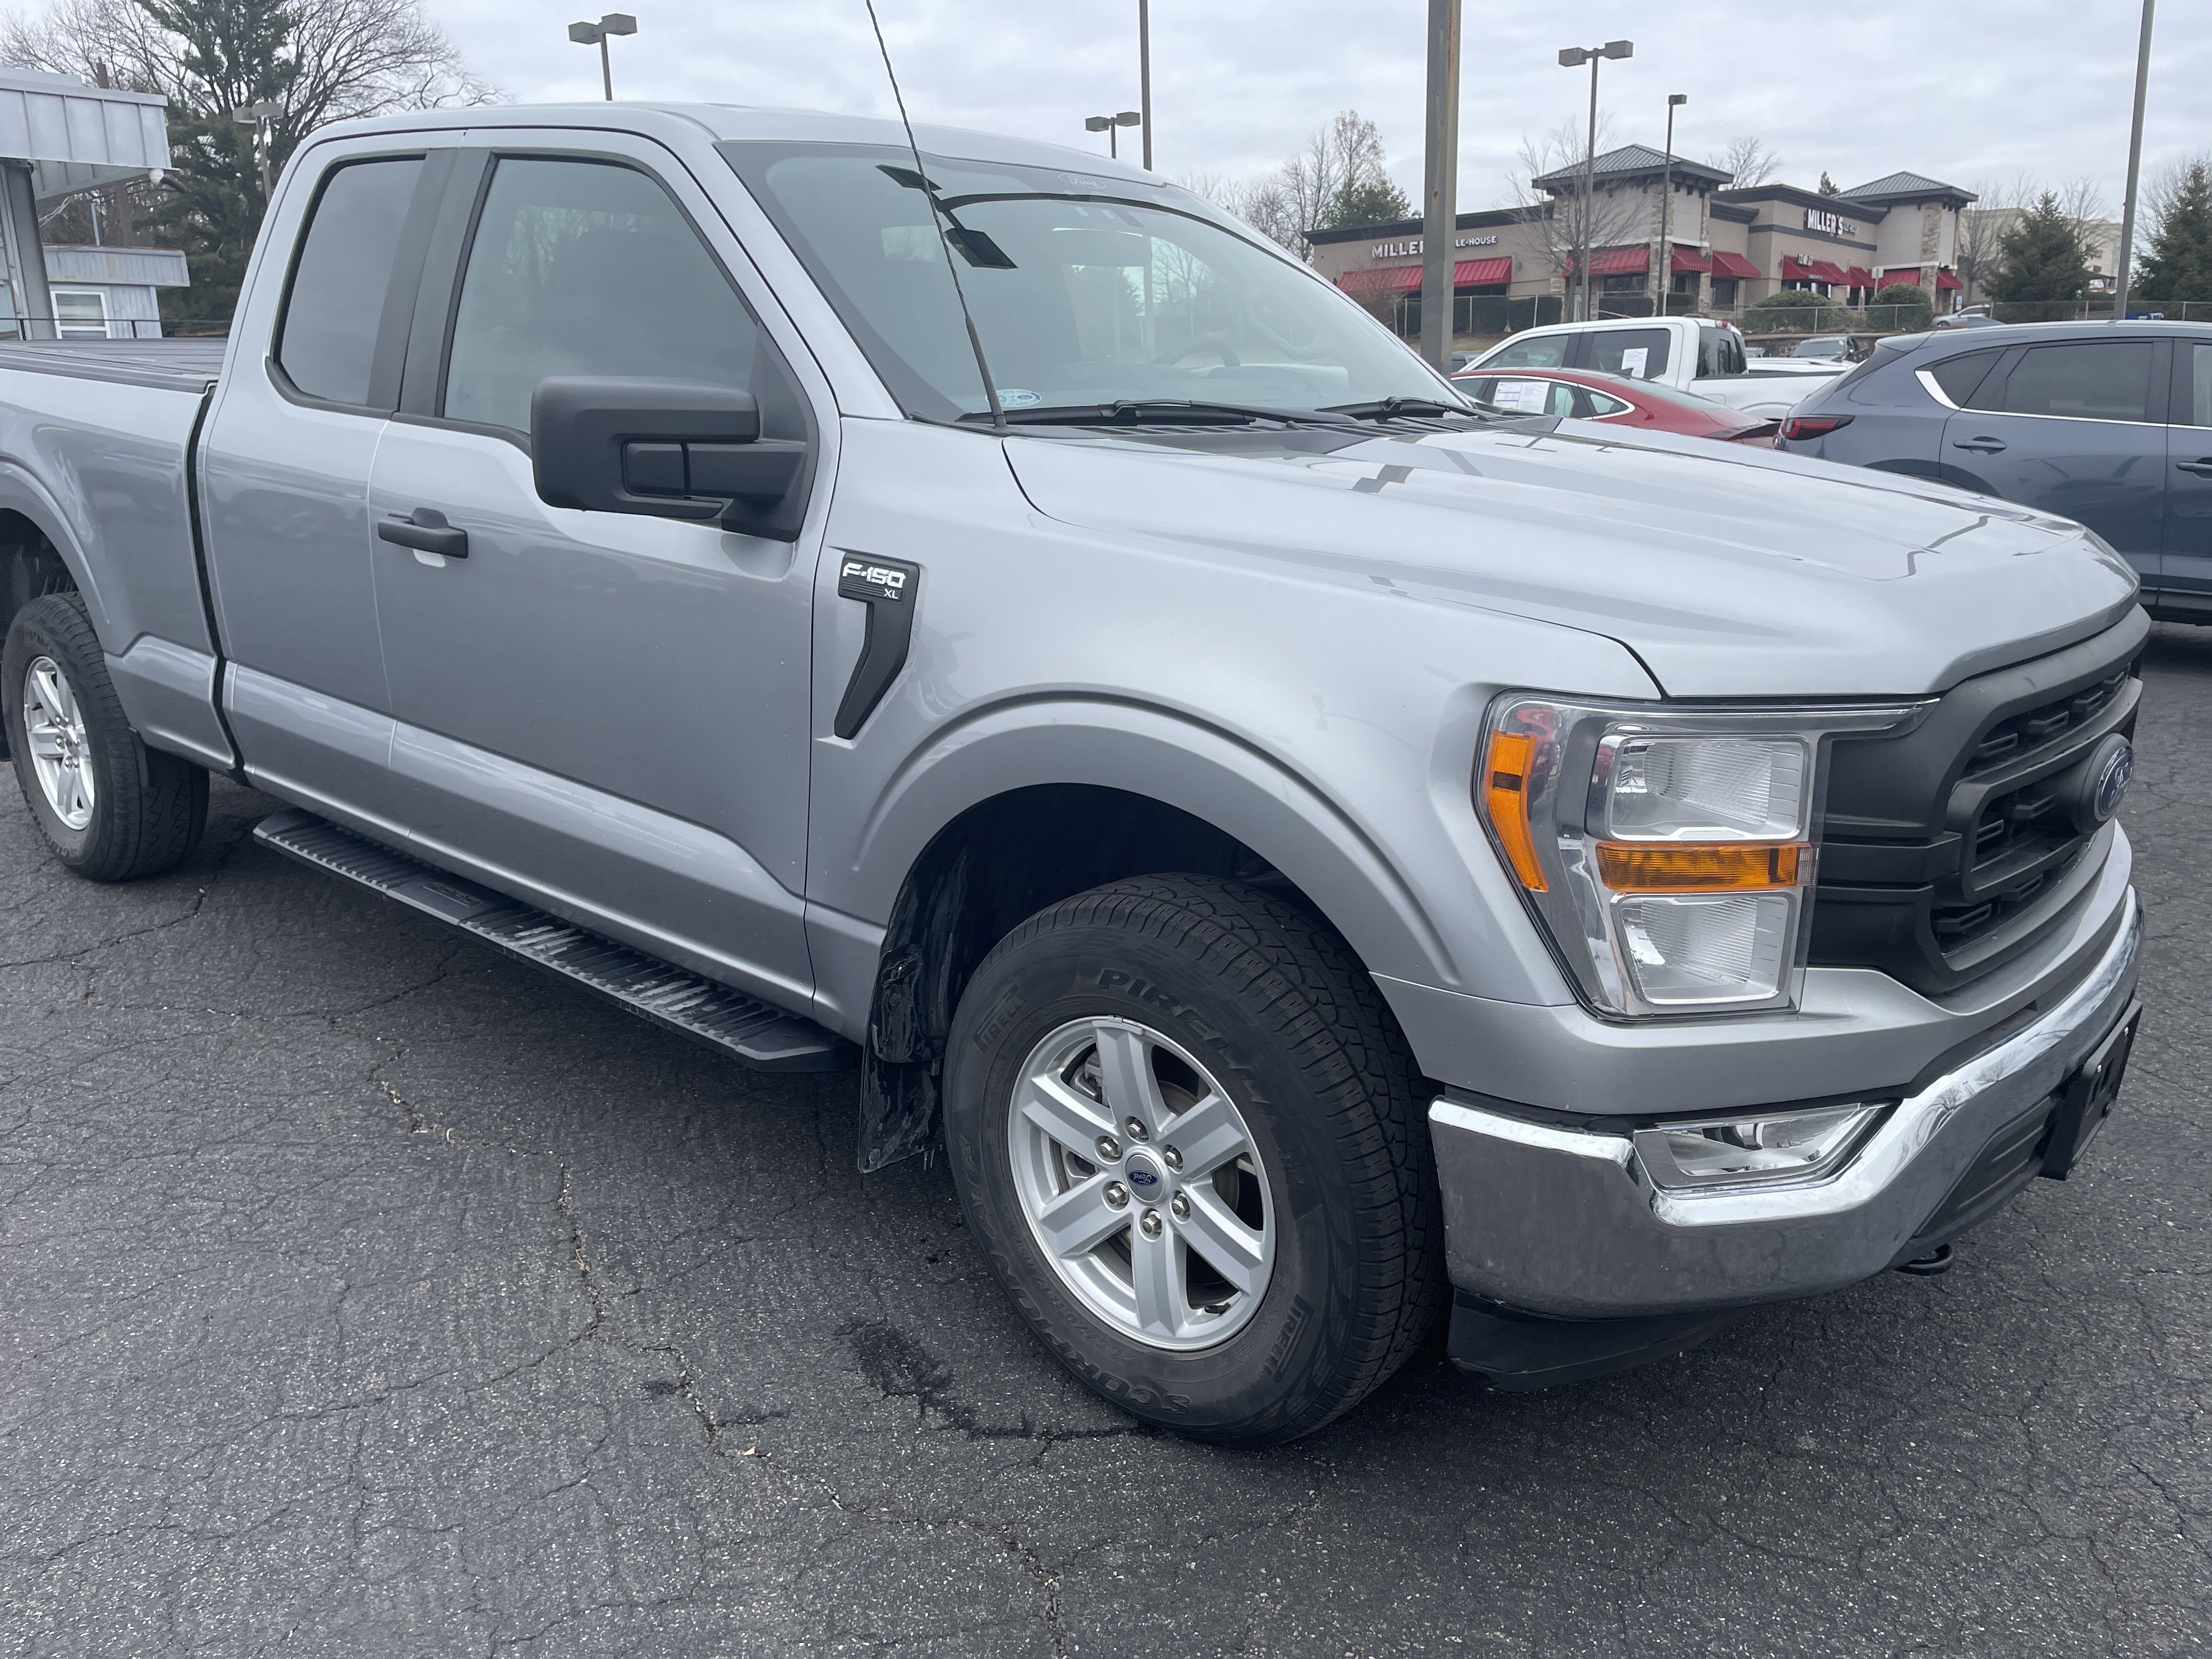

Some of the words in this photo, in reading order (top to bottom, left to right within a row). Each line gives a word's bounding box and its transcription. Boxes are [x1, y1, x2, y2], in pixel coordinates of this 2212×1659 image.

[1807, 208, 1843, 235] MILLER'S
[1372, 240, 1424, 258] MILLE
[1455, 236, 1497, 247] LE-HOUSE
[842, 562, 906, 588] F-150
[884, 589, 898, 599] XL
[971, 984, 1027, 1054] PIRELLI
[1098, 969, 1277, 1116] PIRELLI
[1132, 1173, 1152, 1184] Ford
[990, 1251, 1190, 1414] SCORPION
[1263, 1293, 1314, 1383] PIRELLI
